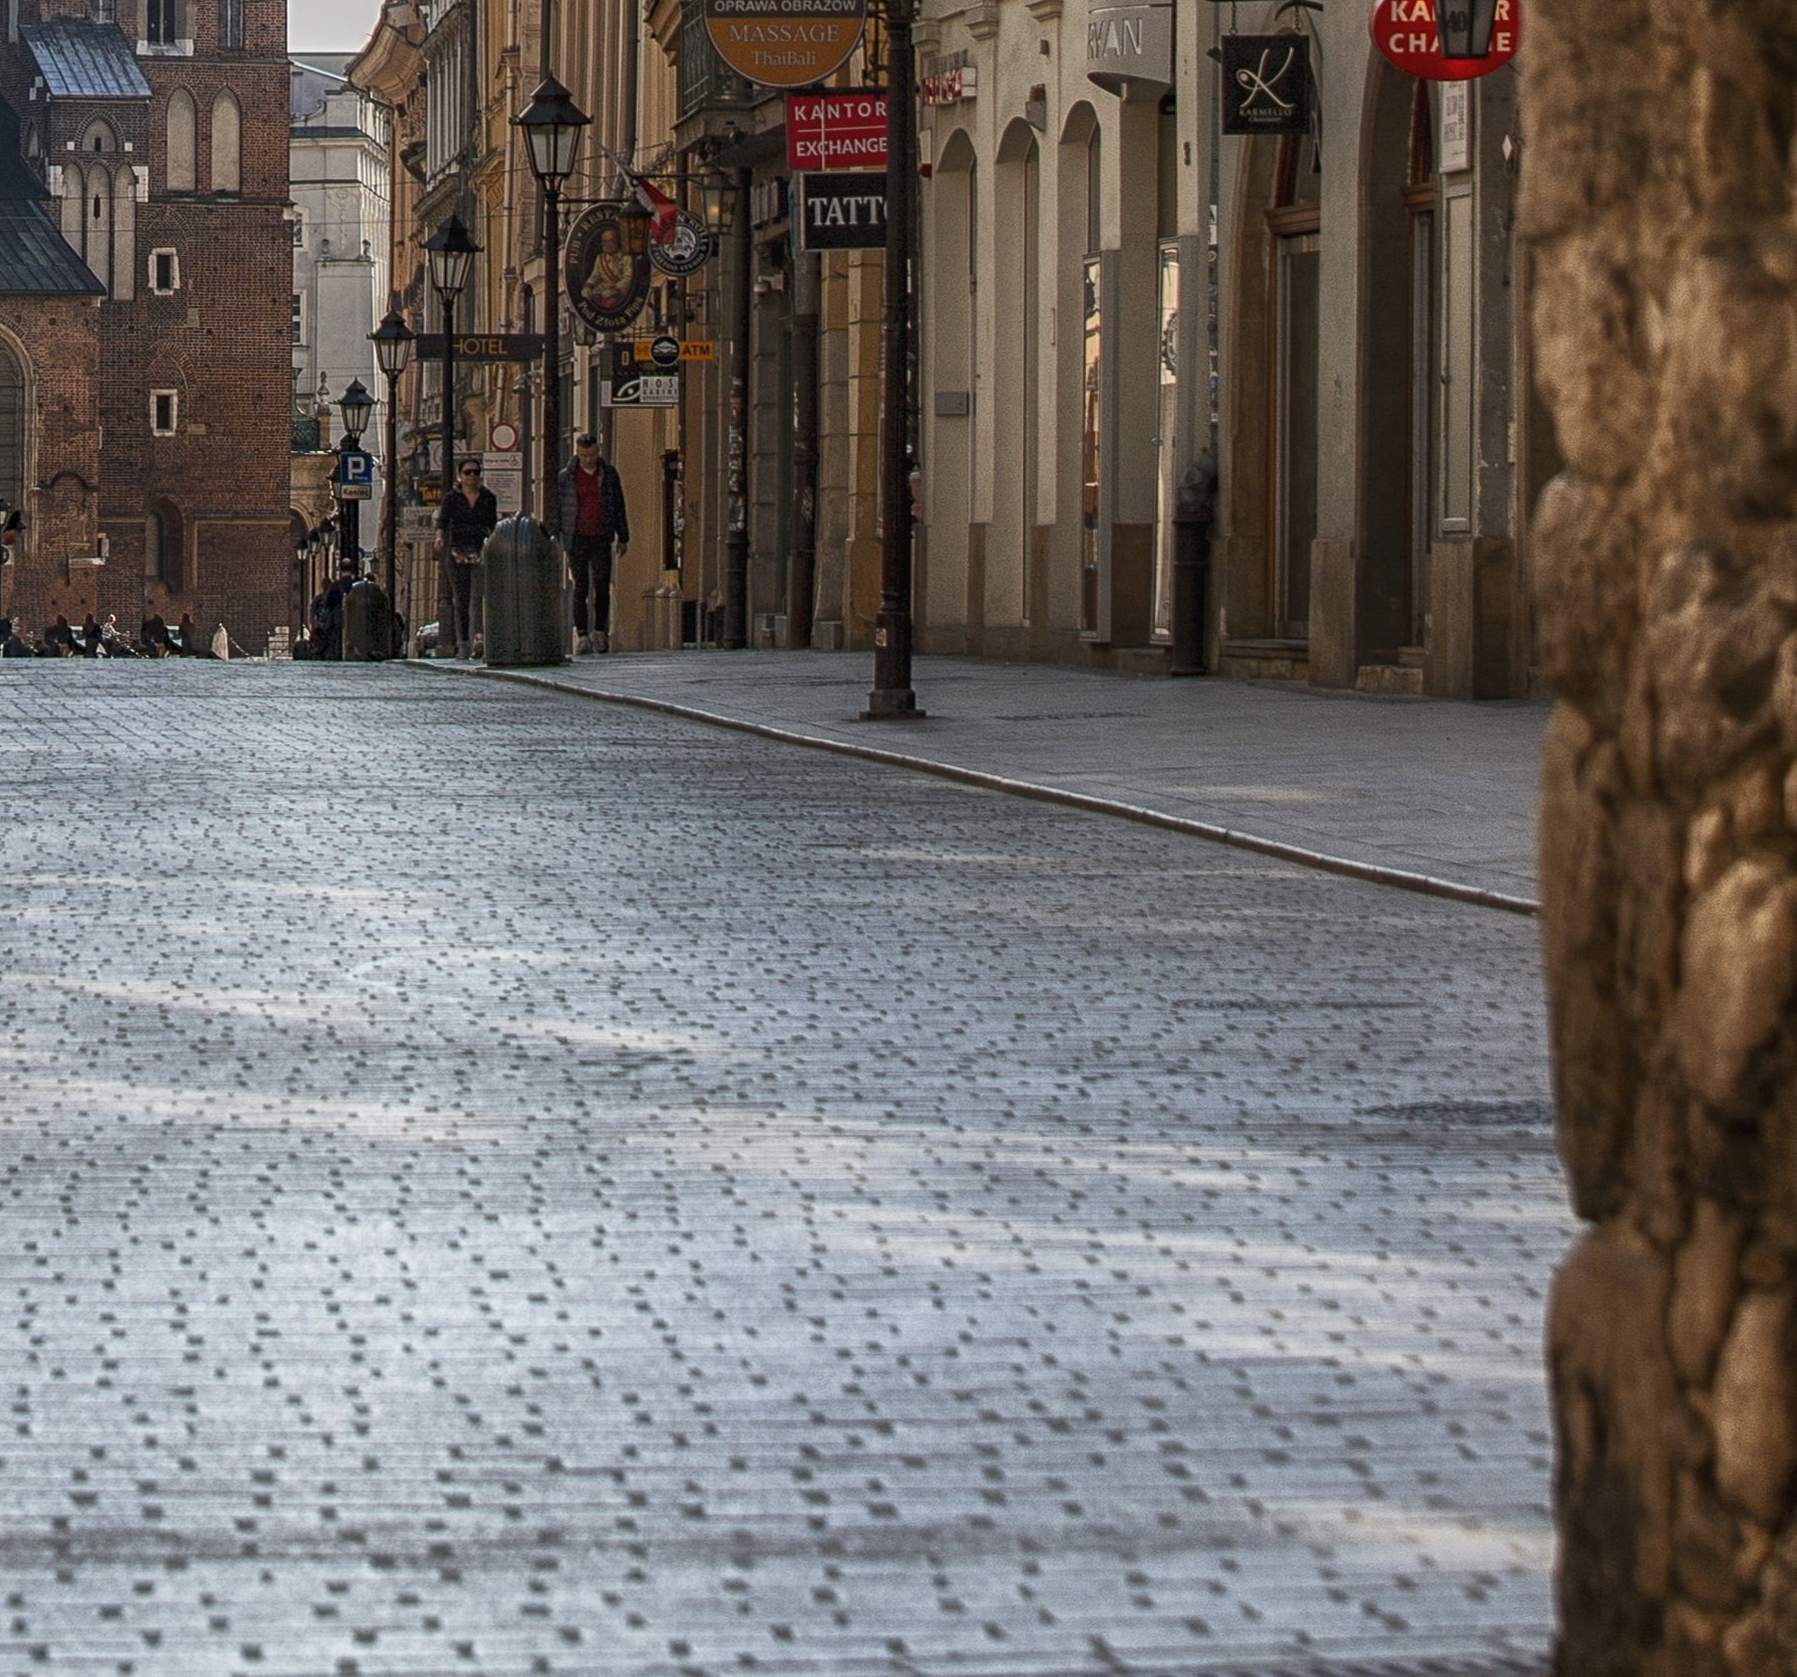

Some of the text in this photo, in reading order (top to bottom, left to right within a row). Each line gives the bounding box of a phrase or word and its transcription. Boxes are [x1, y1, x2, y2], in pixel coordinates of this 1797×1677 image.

[714, 0, 778, 12] OPRAWA
[729, 24, 840, 43] MASSAGE
[750, 51, 817, 66] ThaiBali
[794, 101, 888, 122] KANTOR
[795, 136, 888, 157] EXCHANGE
[807, 196, 888, 227] TATT
[683, 344, 710, 356] ATM
[347, 456, 366, 480] P
